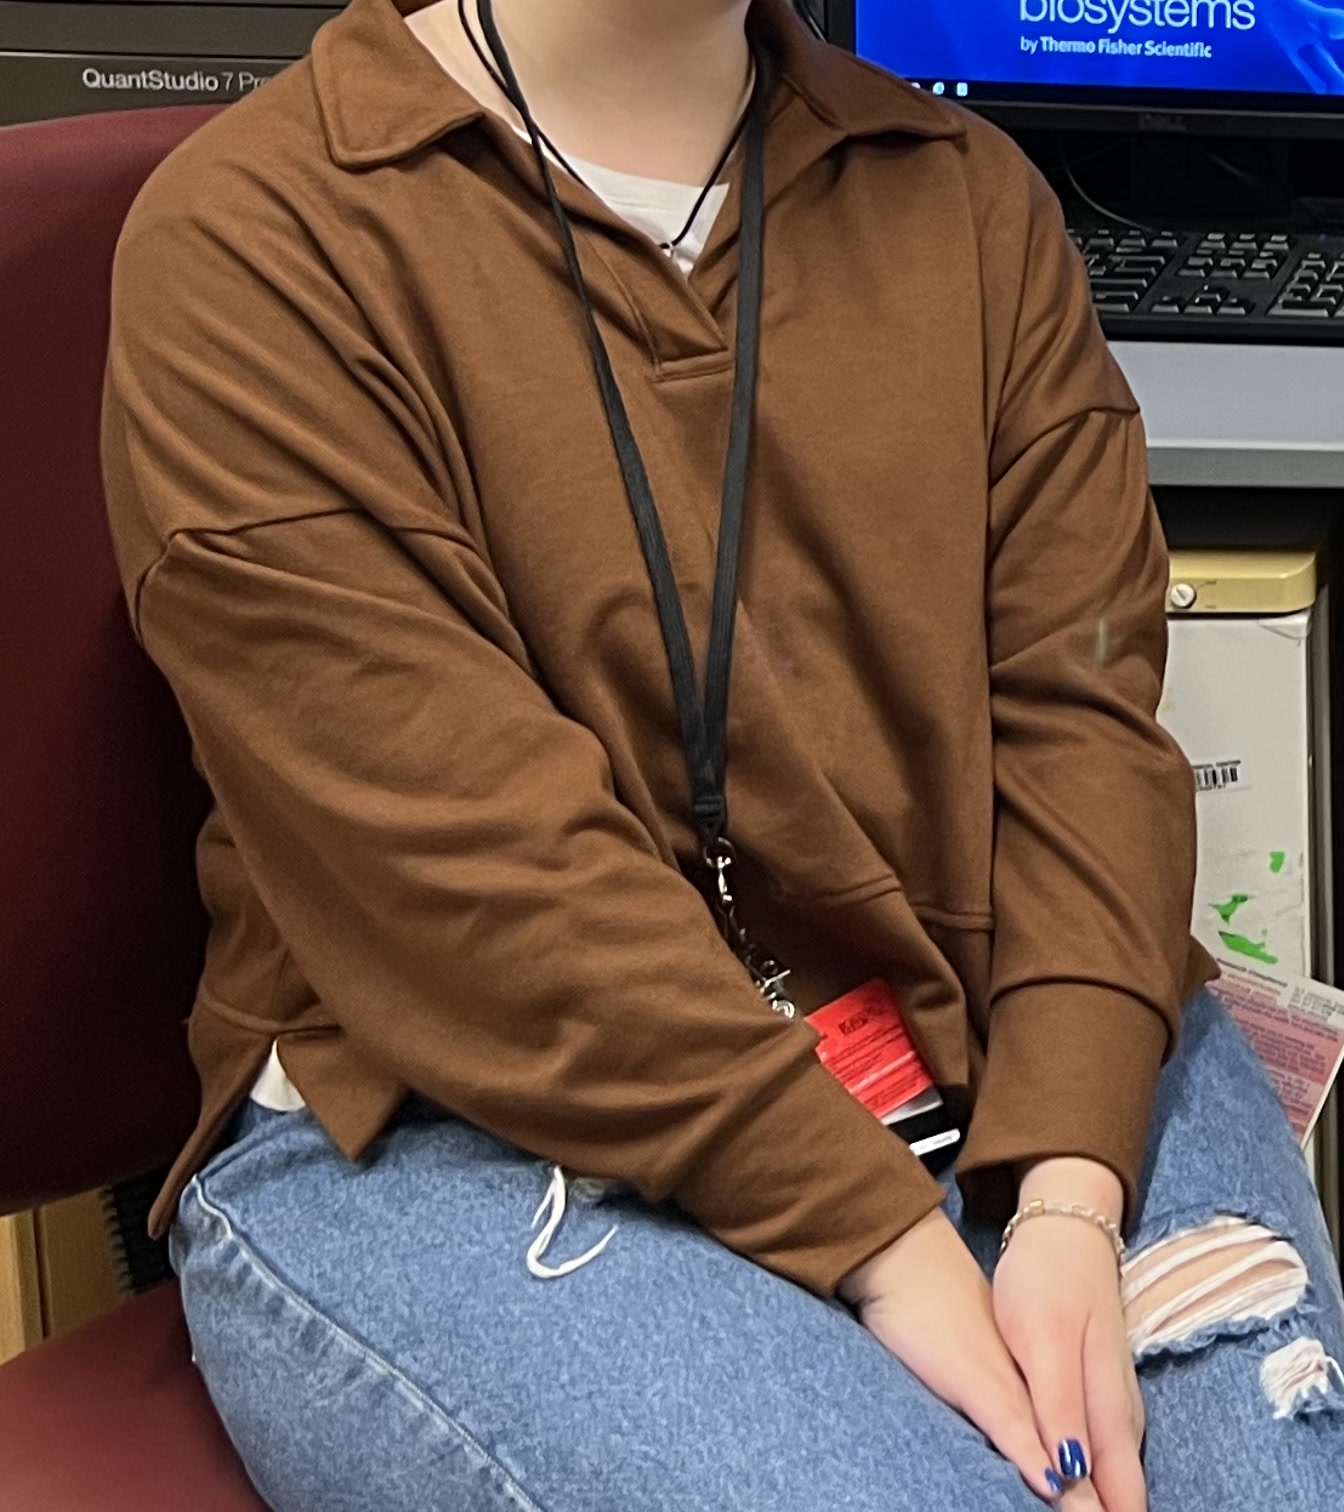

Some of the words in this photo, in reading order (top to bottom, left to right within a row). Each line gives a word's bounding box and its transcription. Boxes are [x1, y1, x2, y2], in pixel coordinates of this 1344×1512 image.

[1020, 36, 1038, 54] by
[1040, 36, 1096, 54] Thermo
[1098, 39, 1142, 55] Fisher
[1144, 40, 1213, 58] Scientific
[82, 67, 219, 91] QuantStudio
[222, 72, 234, 90] 7
